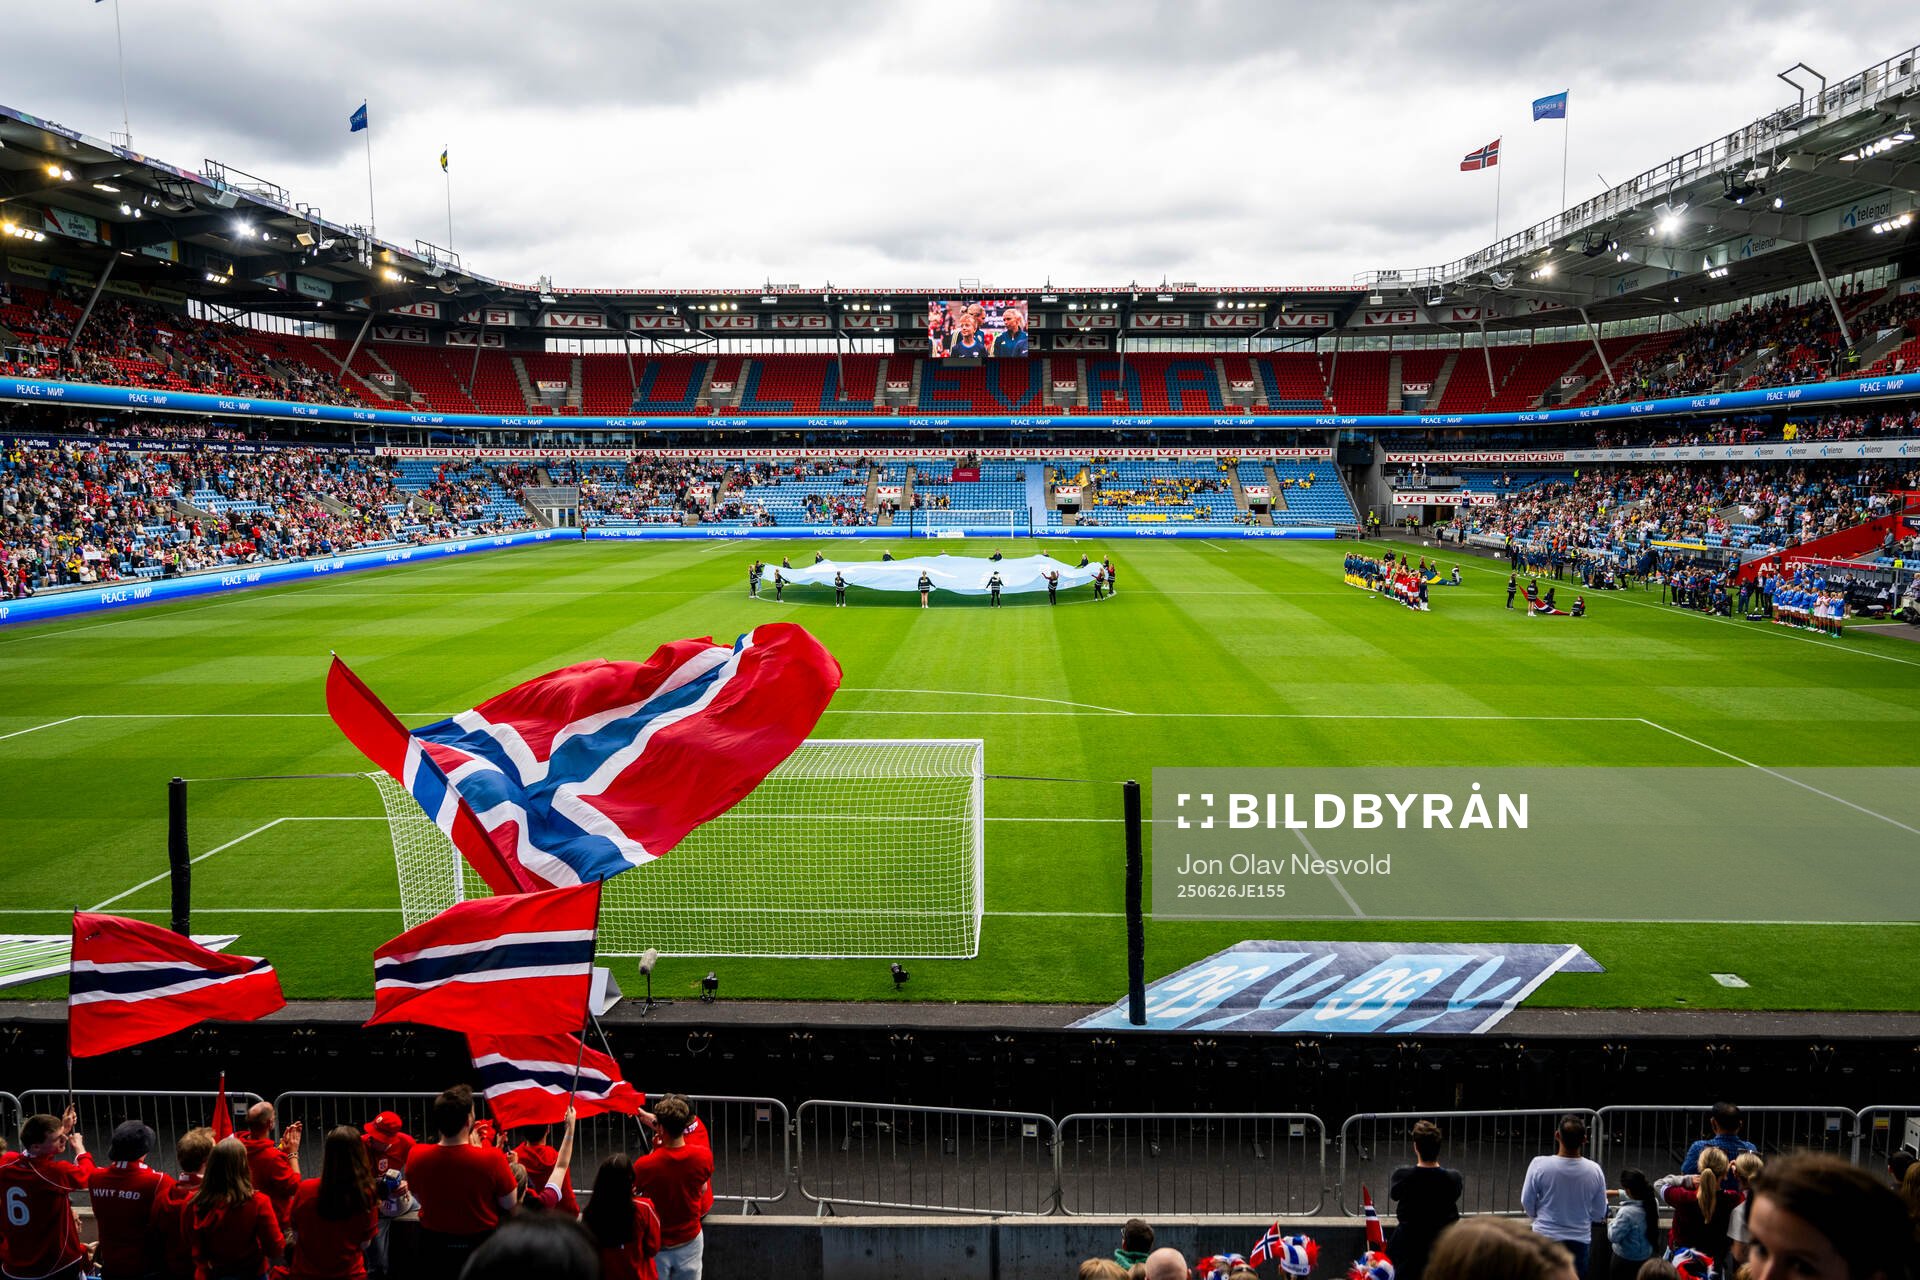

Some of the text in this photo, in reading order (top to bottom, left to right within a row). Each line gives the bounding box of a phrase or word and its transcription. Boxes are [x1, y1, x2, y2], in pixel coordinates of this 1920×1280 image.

[1858, 203, 1889, 222] telenor
[1752, 238, 1777, 252] telenor
[552, 314, 600, 328] VG
[636, 316, 684, 328] VG
[705, 316, 754, 328] VG
[777, 316, 826, 328] VG
[845, 316, 894, 328] VG
[1066, 315, 1112, 327] VG
[1136, 314, 1184, 326] VG
[1210, 314, 1260, 326] VG
[1279, 314, 1328, 326] VG
[1365, 310, 1416, 324] VG
[376, 327, 426, 342] VG
[452, 332, 499, 346] VG
[1056, 336, 1105, 348] VG
[16, 384, 40, 395] PEACE
[1860, 382, 1880, 392] PEACE
[128, 394, 148, 403] PEACE
[1767, 392, 1782, 400] PEACE
[219, 401, 235, 410] PEACE
[1864, 445, 1883, 453] telenor
[1906, 444, 1920, 452] telen
[878, 487, 902, 496] VG
[1057, 486, 1082, 495] VG
[1246, 486, 1270, 495] VG
[1434, 496, 1462, 504] VG
[1471, 496, 1494, 504] VG
[222, 576, 242, 586] PEACE
[102, 590, 127, 604] PEACE
[118, 1190, 140, 1200] RØD
[6, 1186, 30, 1226] 6
